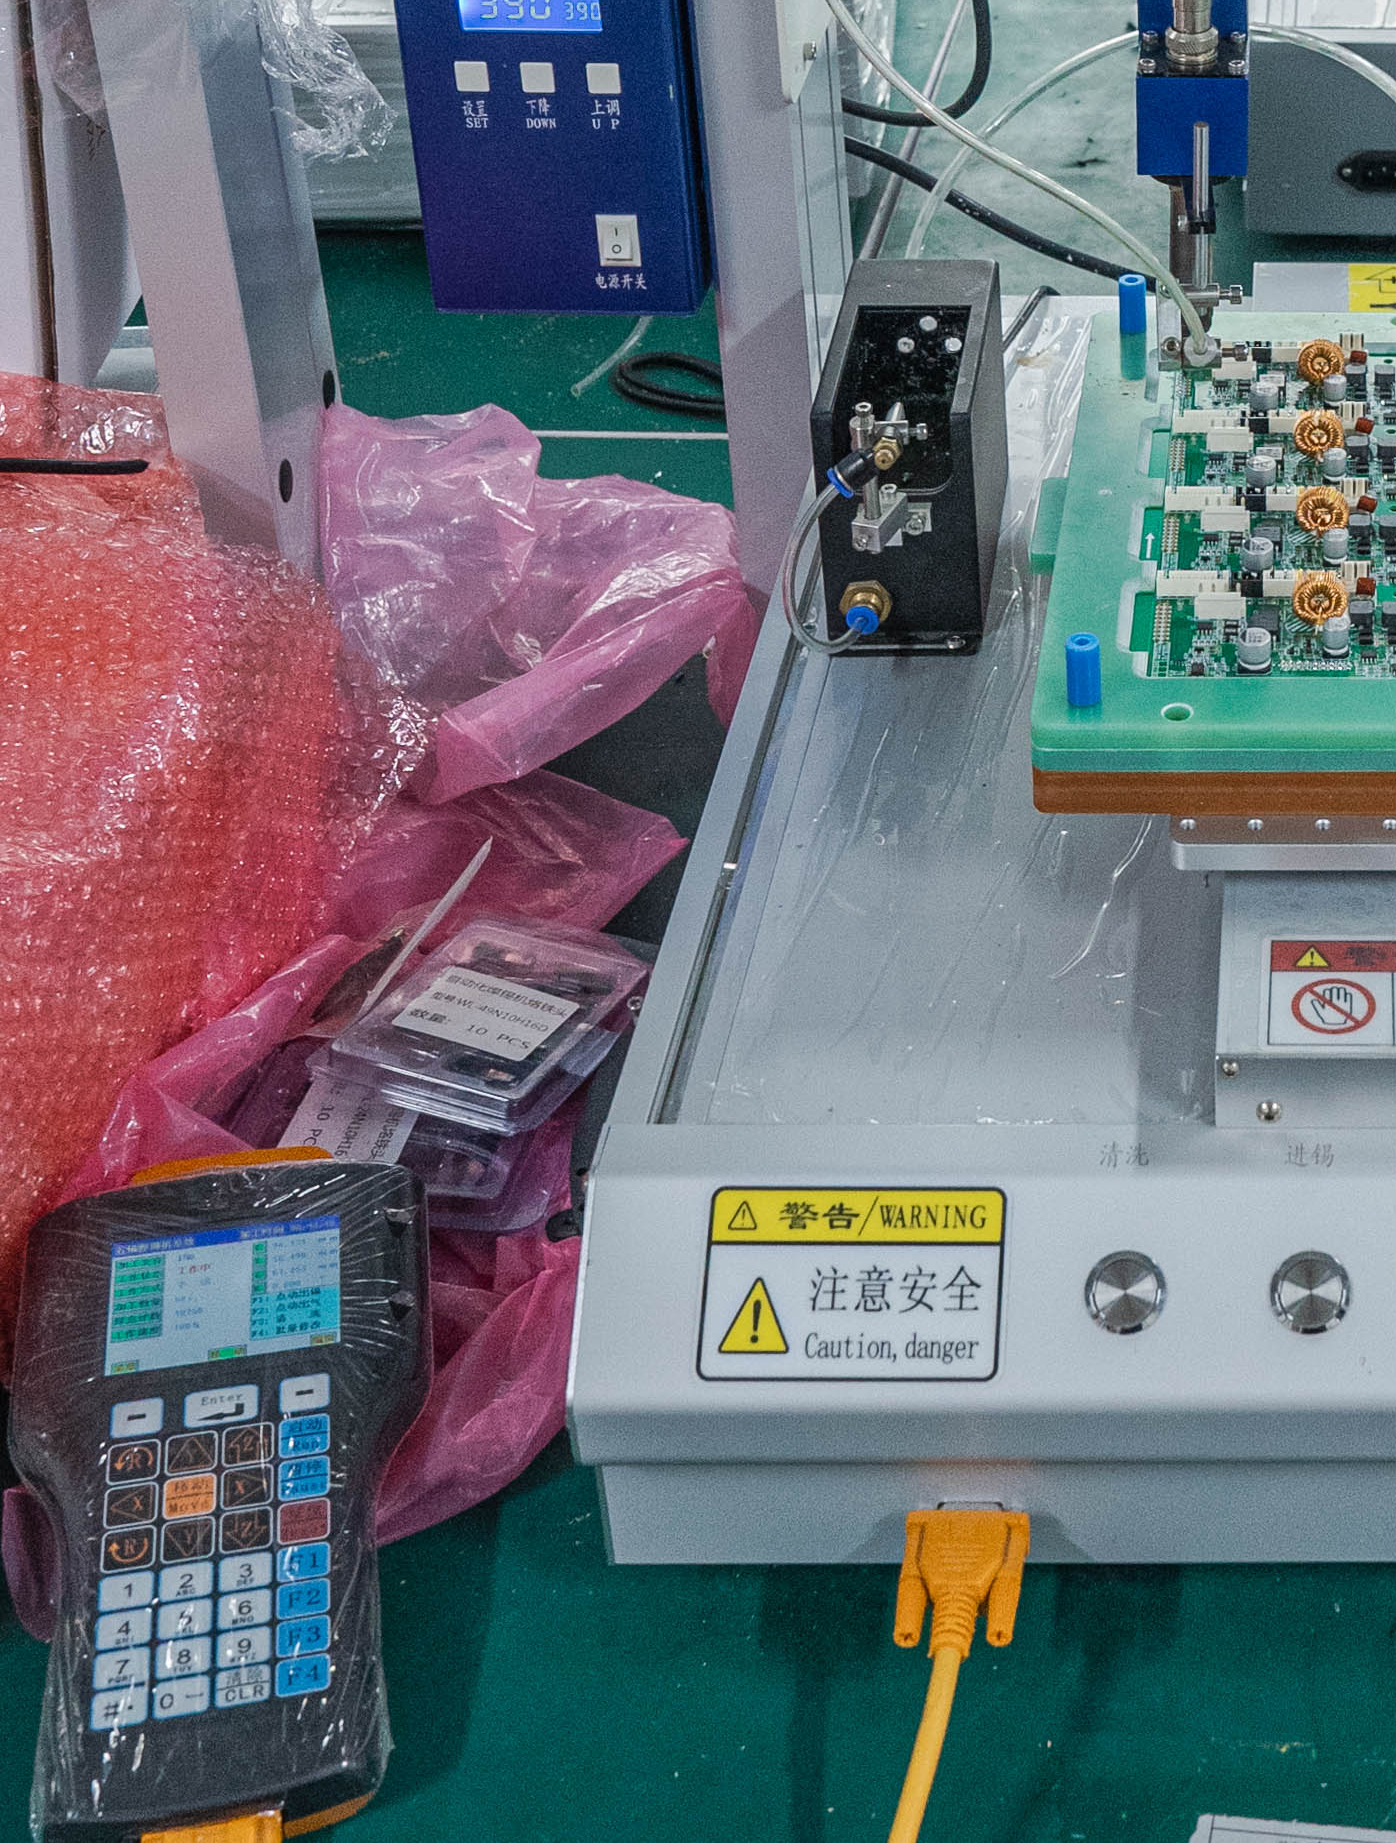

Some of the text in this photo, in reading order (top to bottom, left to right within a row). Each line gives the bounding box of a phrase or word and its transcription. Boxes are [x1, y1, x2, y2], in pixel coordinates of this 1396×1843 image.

[462, 100, 488, 117] 设置
[526, 98, 551, 116] 下降
[590, 99, 620, 117] 上调
[466, 118, 489, 129] SET
[526, 118, 557, 129] DOWN
[595, 272, 647, 290] 电源开关
[468, 1024, 488, 1035] 10
[497, 1034, 533, 1050] PCS
[303, 1128, 322, 1145] PC
[1099, 1141, 1150, 1167] 清洗
[1285, 1141, 1335, 1168] 进锡
[779, 1196, 987, 1237] 警告/WARNING
[810, 1265, 982, 1313] 注意安全
[201, 1391, 243, 1406] Enter
[240, 1564, 253, 1579] 3
[180, 1573, 194, 1590] 2
[124, 1583, 133, 1598] 1
[288, 1588, 322, 1608] F2
[238, 1600, 252, 1616] 6
[117, 1620, 131, 1636] 4
[288, 1626, 321, 1648] F3
[238, 1638, 252, 1654] 9
[177, 1649, 191, 1665] 8
[116, 1659, 130, 1675] 7
[287, 1665, 319, 1686] F4
[224, 1686, 265, 1703] CLR
